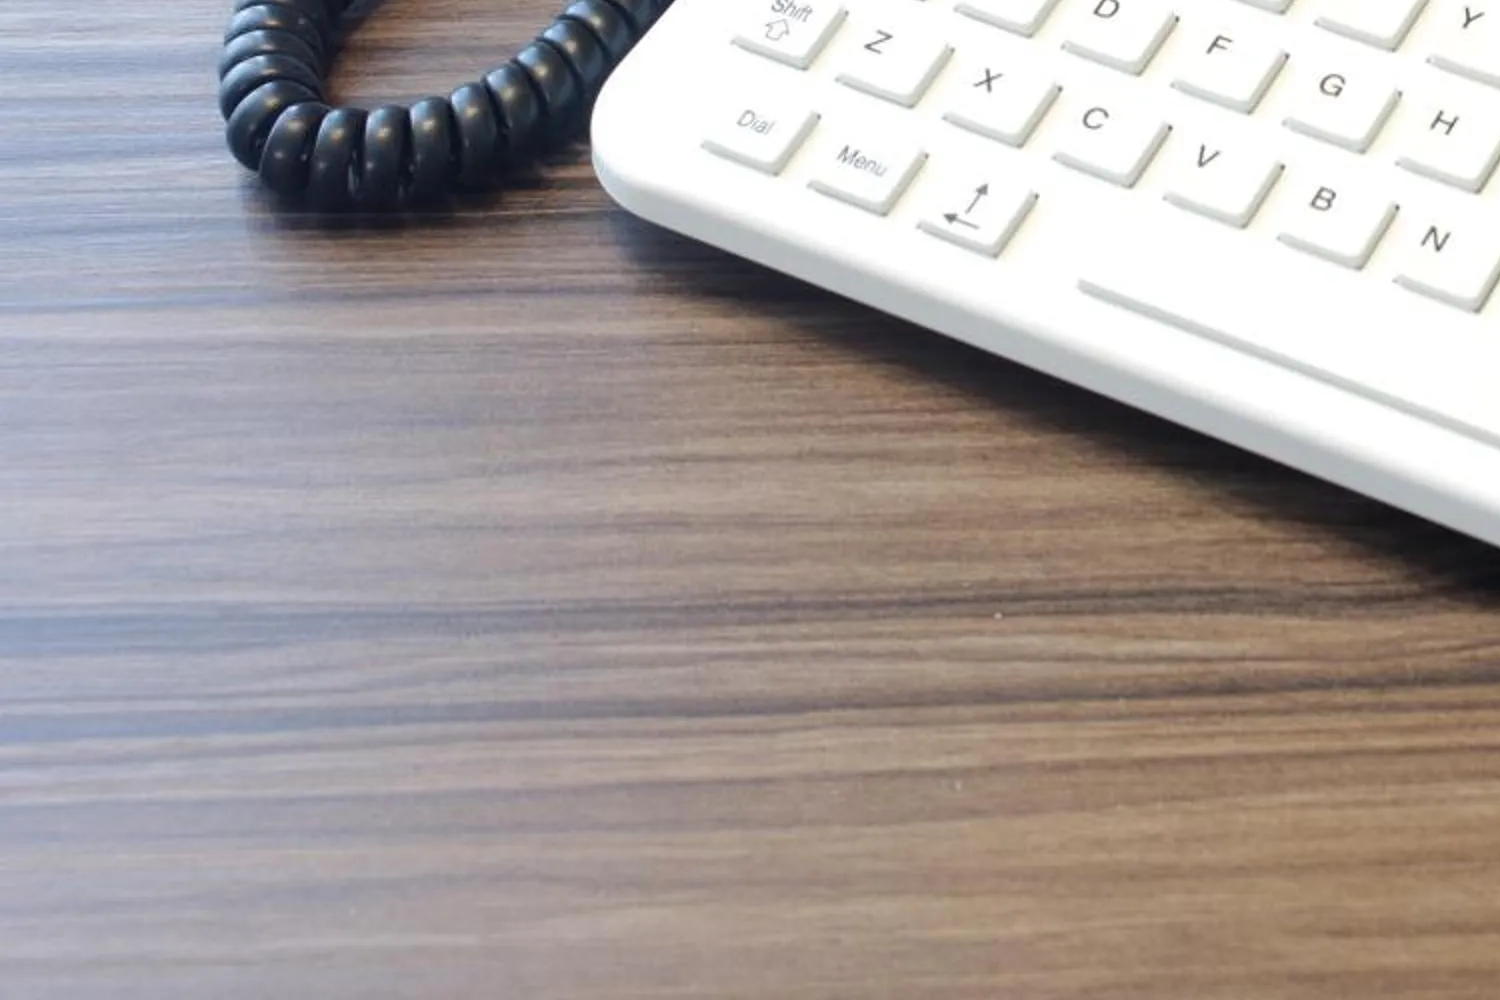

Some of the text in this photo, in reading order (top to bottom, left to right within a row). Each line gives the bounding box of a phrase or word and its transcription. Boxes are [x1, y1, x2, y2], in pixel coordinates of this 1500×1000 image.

[1462, 7, 1485, 29] Y
[863, 29, 894, 55] Z
[1206, 34, 1233, 55] F
[973, 67, 1003, 93] X
[1319, 73, 1346, 98] G
[735, 108, 776, 136] Dial
[1081, 106, 1110, 131] C
[1430, 110, 1459, 136] H
[836, 144, 888, 178] Menu
[1197, 143, 1221, 169] V
[1309, 186, 1337, 212] B
[1420, 225, 1451, 253] N
